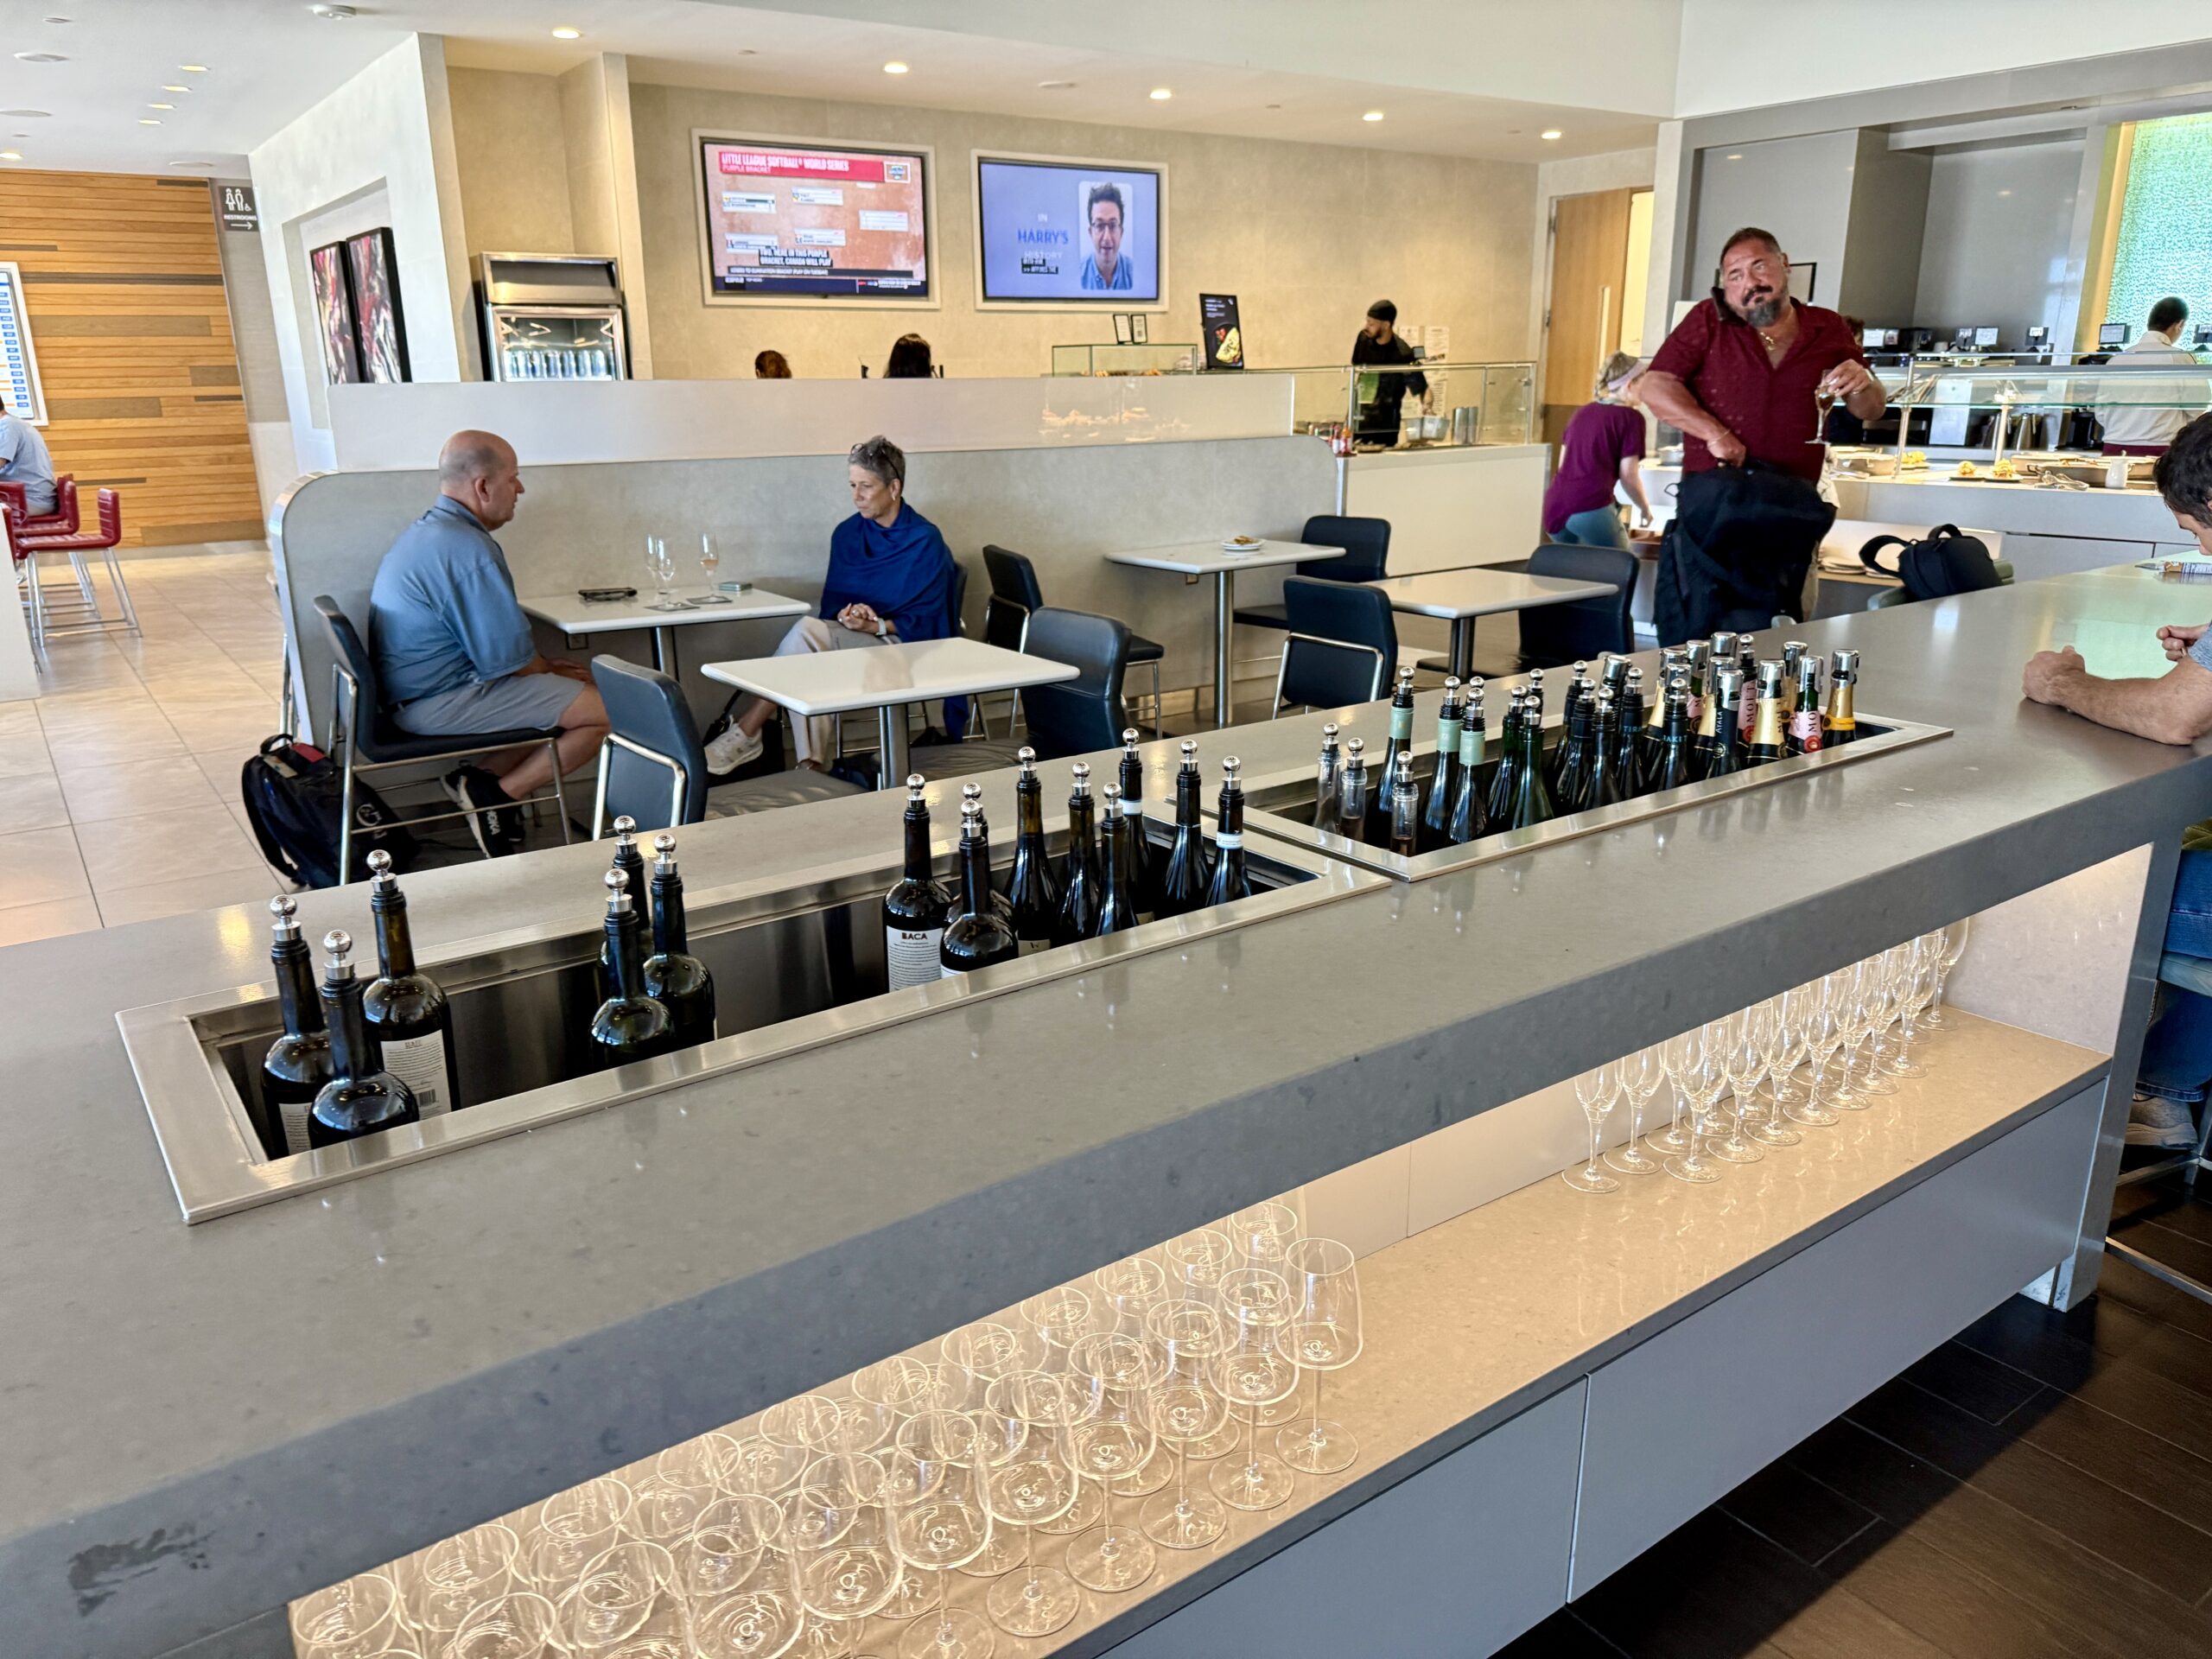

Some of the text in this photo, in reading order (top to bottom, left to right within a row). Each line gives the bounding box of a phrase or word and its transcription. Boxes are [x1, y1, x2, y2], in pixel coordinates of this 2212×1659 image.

[721, 152, 742, 165] LITTLE
[742, 154, 766, 167] LEAGUE
[803, 157, 827, 170] WORLD
[827, 159, 849, 172] SERIES
[1018, 228, 1069, 245] HARRY'S
[901, 931, 928, 940] BACA
